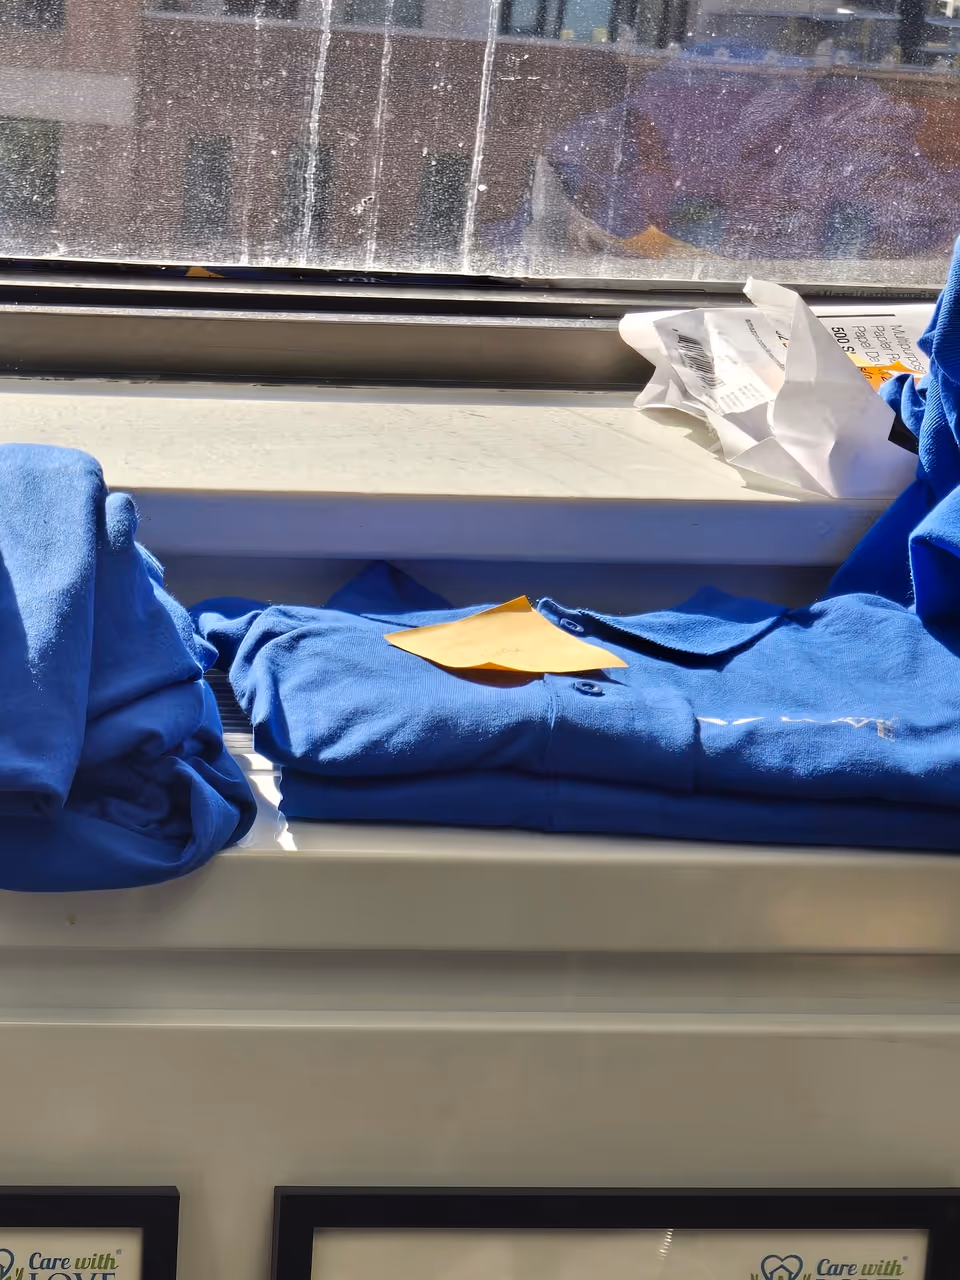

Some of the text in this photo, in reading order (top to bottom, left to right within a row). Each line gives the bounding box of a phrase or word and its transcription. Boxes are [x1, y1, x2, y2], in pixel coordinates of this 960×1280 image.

[831, 326, 850, 345] 500
[851, 325, 876, 351] Papel
[870, 325, 894, 352] Papier
[29, 1252, 118, 1270] Care with
[817, 1259, 905, 1277] Care with
